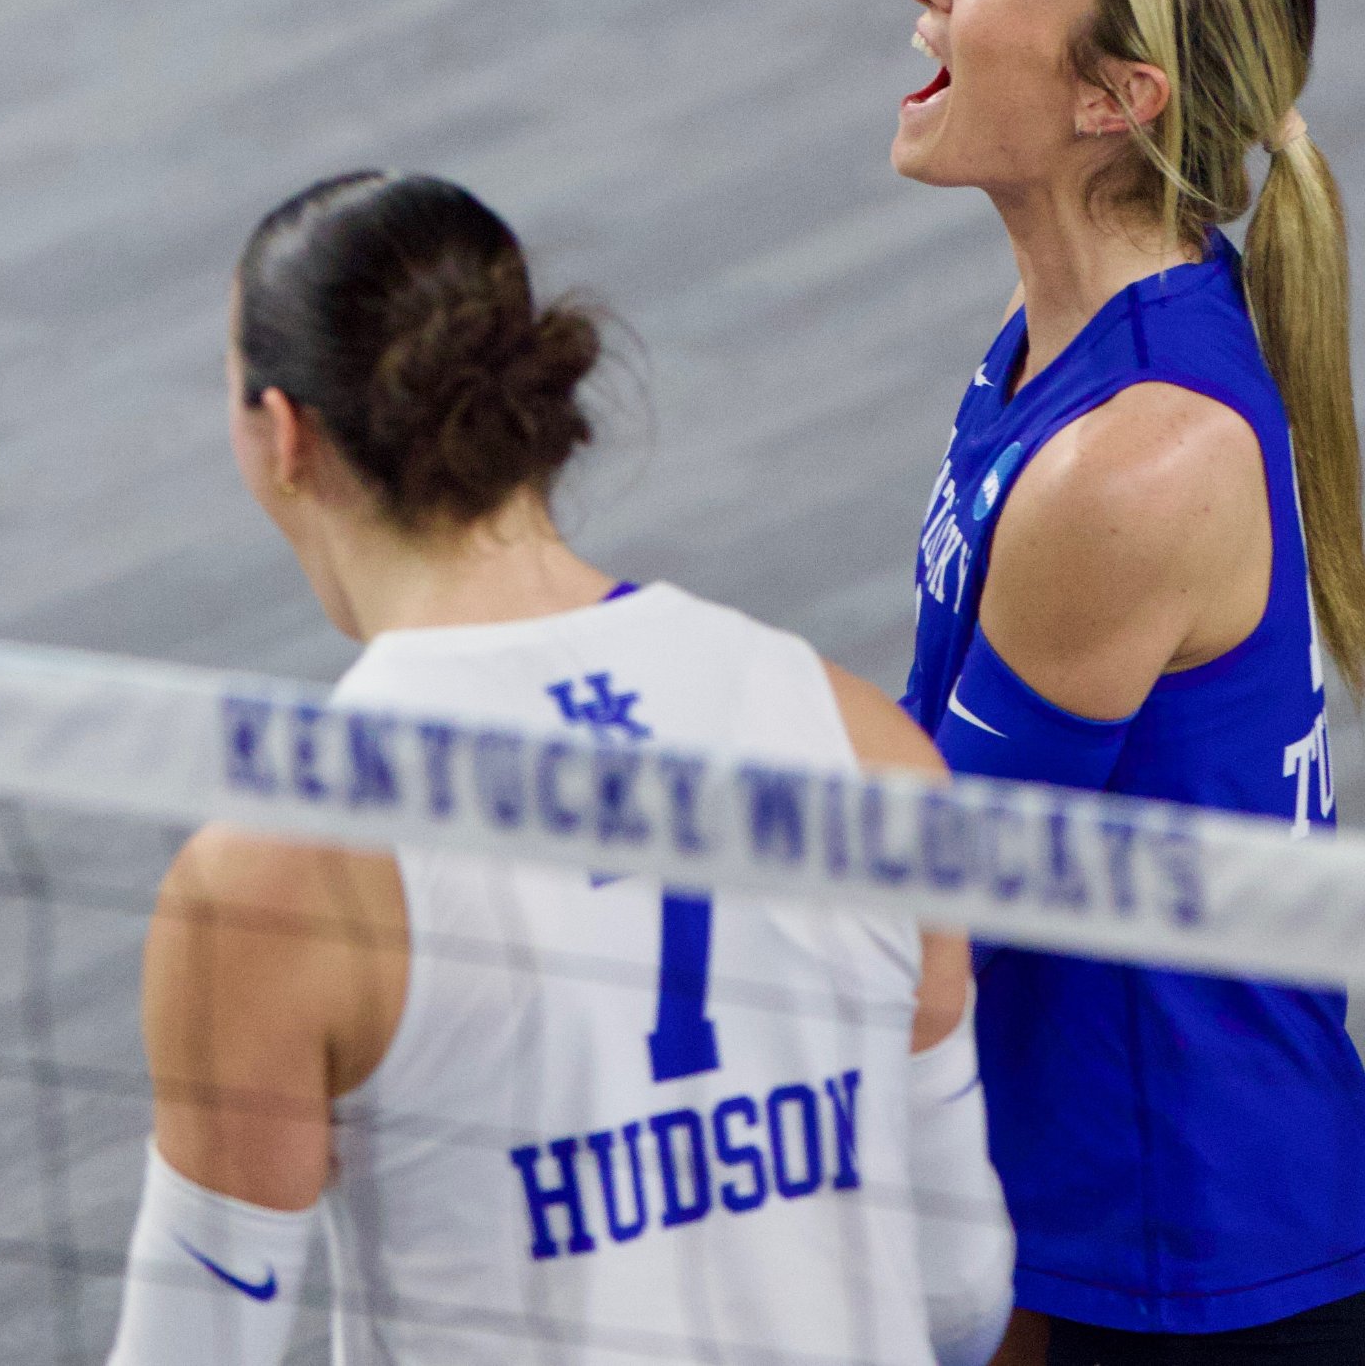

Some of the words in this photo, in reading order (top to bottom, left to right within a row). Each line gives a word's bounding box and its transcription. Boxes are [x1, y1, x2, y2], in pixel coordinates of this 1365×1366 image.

[222, 696, 709, 856] KENTUCKY
[737, 761, 1209, 929] WILDCATS
[510, 1068, 862, 1262] HUDSON
